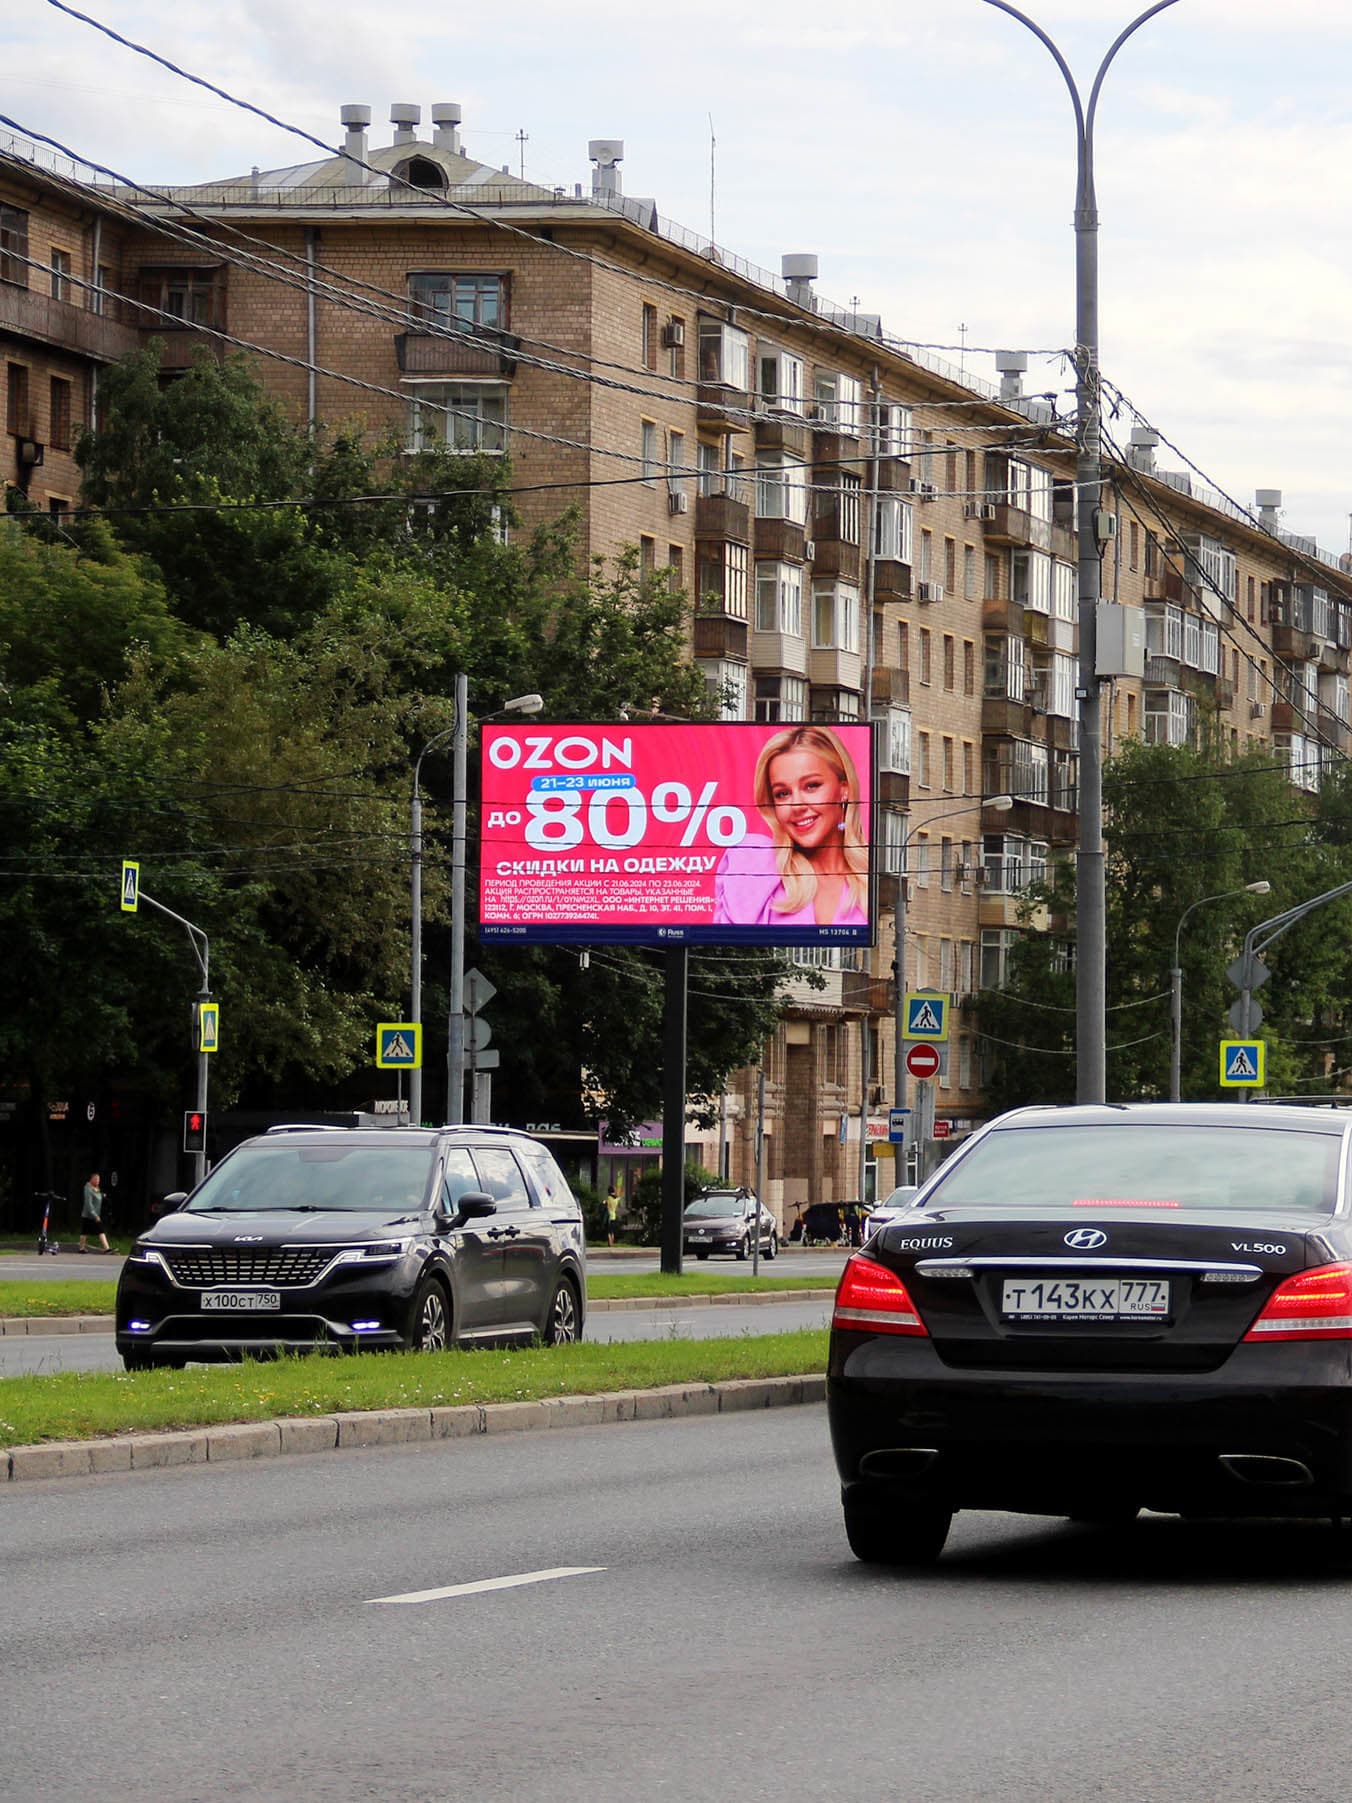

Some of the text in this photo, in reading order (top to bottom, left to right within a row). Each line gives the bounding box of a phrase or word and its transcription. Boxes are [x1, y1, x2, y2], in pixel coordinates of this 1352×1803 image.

[489, 736, 632, 769] OZON
[524, 782, 747, 852] 80%
[496, 856, 717, 877] СКИДКИ НА ОДЕЖДУ
[484, 879, 517, 888] ПЕРИОД
[519, 879, 572, 888] ПРОВЕДЕНИЯ
[574, 879, 602, 888] АКЦИИ
[603, 879, 610, 888] С
[649, 879, 661, 888] ПО
[484, 887, 513, 896] АКЦИЯ
[514, 887, 594, 896] РАСПРОСТРАНЯЕТСЯ
[596, 887, 608, 896] НА
[645, 887, 694, 896] УКАЗАННЫЕ
[484, 896, 497, 904] НА
[602, 896, 622, 904] ООО
[555, 904, 615, 912] ПРЕСНЕНСКАЯ
[900, 1236, 953, 1251] EQUUS
[1231, 1242, 1287, 1255] VL500
[204, 1293, 277, 1308] Х100СТ 750
[1012, 1282, 1162, 1309] Т143КХ 777
[1130, 1303, 1151, 1311] RUS
